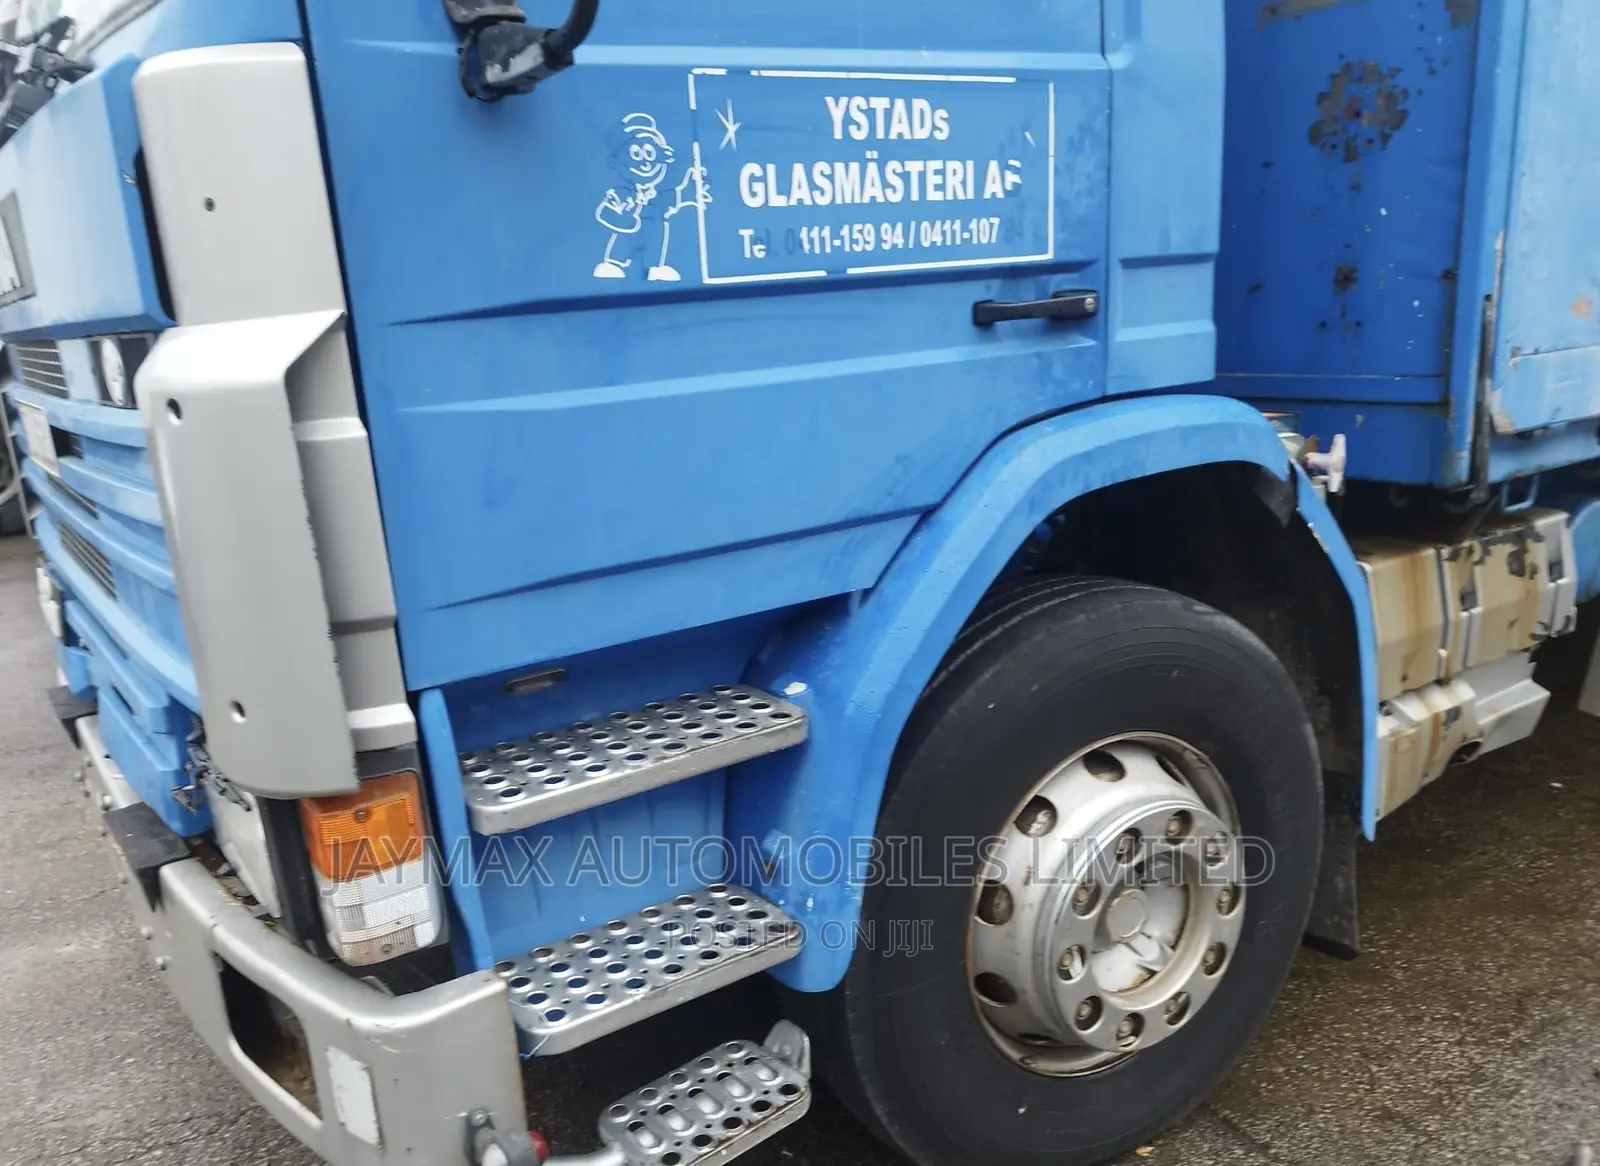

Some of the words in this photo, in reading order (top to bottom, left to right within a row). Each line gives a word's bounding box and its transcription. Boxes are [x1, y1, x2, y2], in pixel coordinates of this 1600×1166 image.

[824, 95, 950, 140] YSTADs
[739, 150, 975, 208] GLASMÄSTERI
[880, 221, 905, 250] 94
[908, 220, 917, 249] /
[919, 216, 1001, 248] 0411-107
